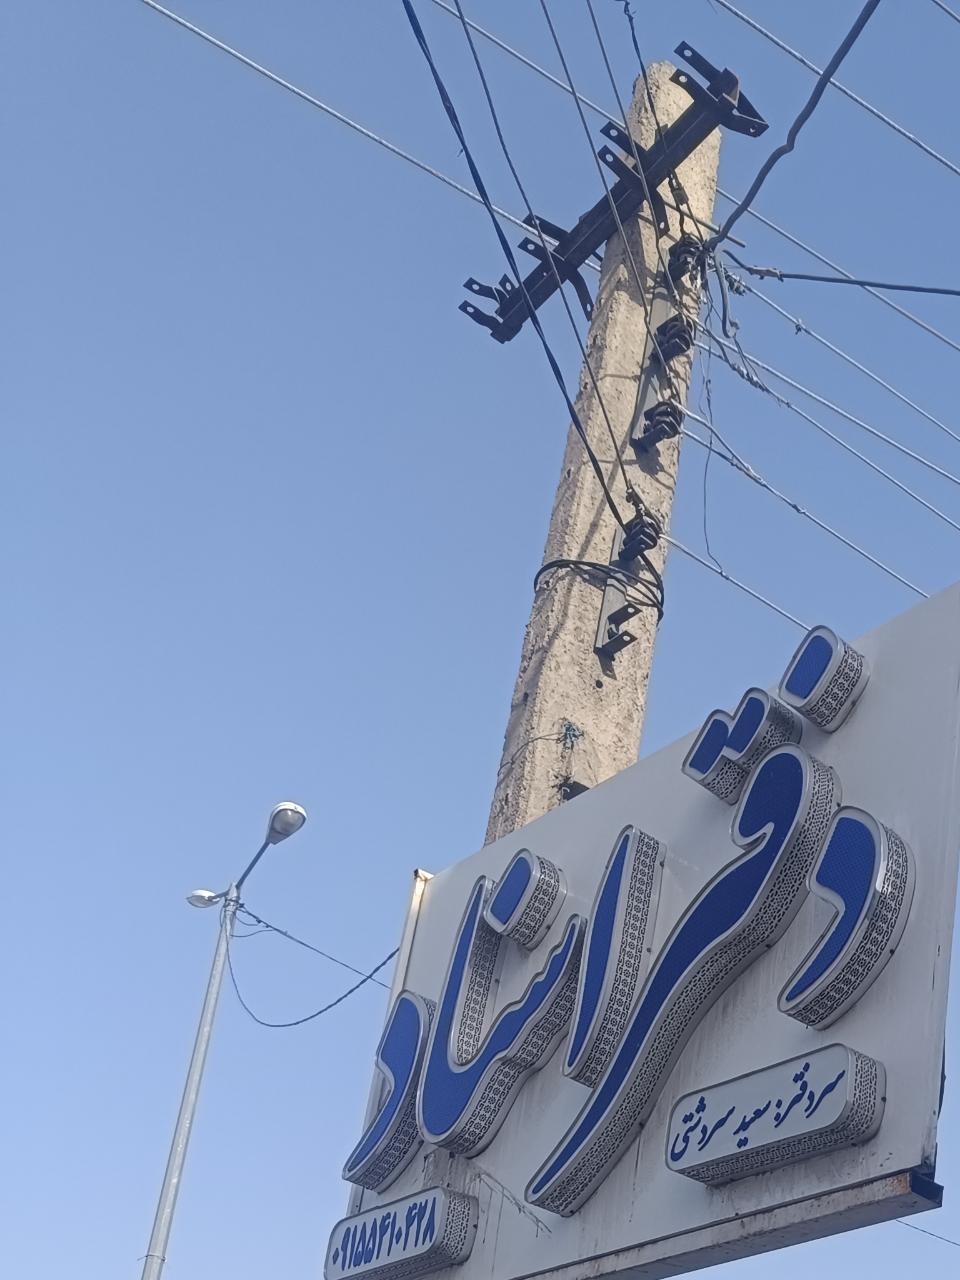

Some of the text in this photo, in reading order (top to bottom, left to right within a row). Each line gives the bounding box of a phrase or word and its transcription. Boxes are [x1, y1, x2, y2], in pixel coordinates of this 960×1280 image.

[343, 625, 908, 1208] دفتر اسناد
[733, 1101, 771, 1148] سعید
